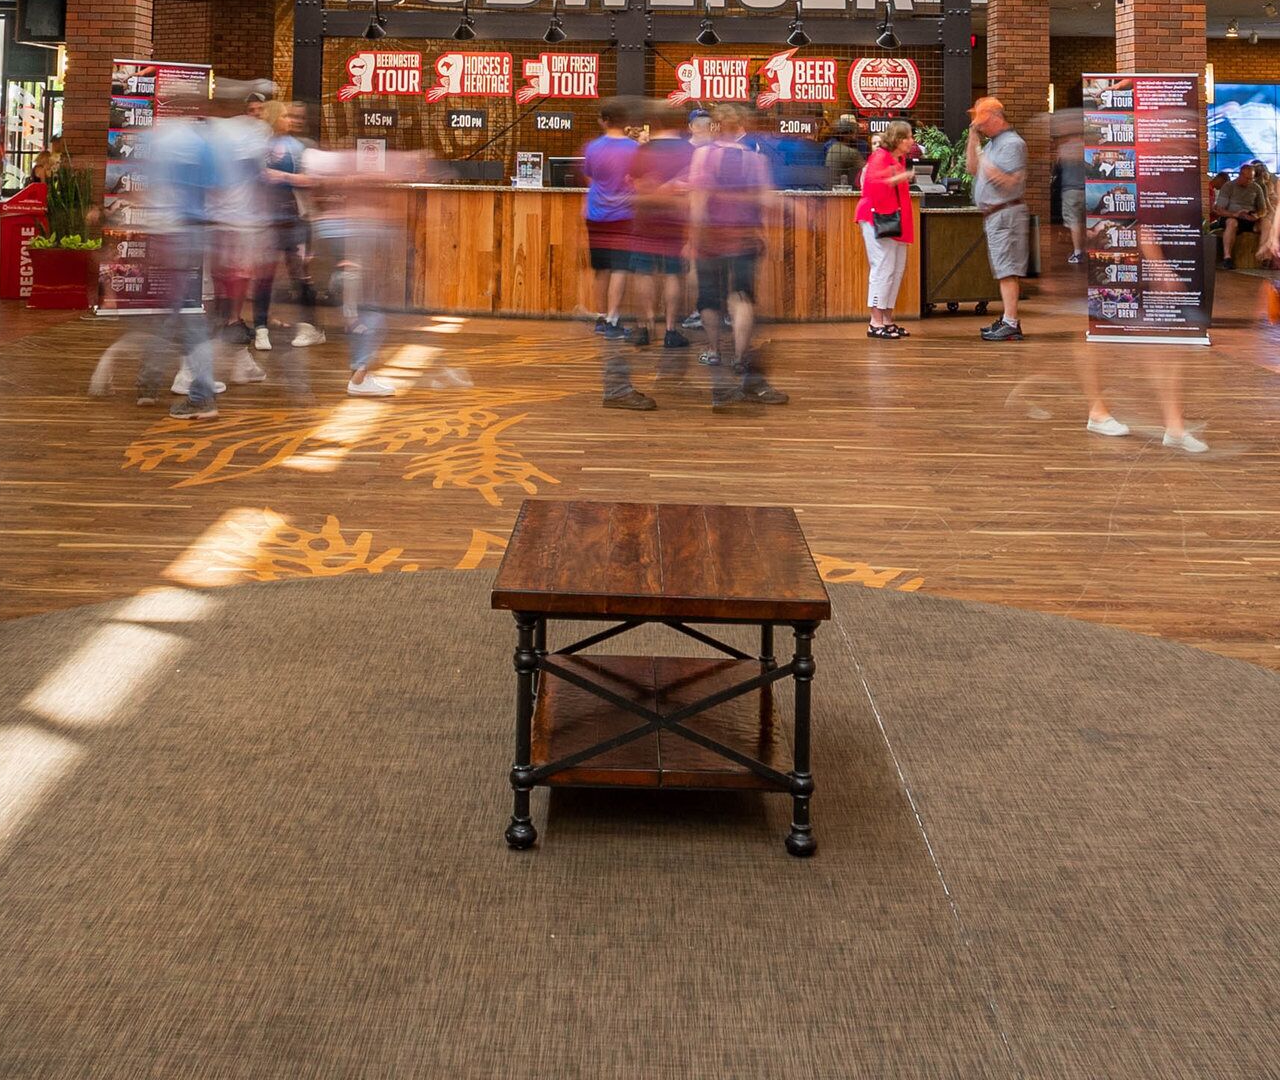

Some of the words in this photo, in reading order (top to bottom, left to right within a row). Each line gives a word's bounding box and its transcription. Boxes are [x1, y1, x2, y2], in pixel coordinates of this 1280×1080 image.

[377, 54, 419, 67] BEERMASTER
[464, 56, 500, 74] HORSES
[503, 56, 509, 74] &
[552, 55, 568, 72] DAY
[570, 56, 596, 73] FRESH
[703, 60, 747, 75] BREWERY
[795, 61, 834, 83] BEER
[376, 70, 419, 92] TOUR
[464, 75, 509, 94] HERITAGE
[552, 73, 595, 95] TOUR
[860, 77, 908, 88] BIERGARTEN
[704, 77, 746, 99] TOUR
[795, 84, 835, 100] SCHOOL
[1113, 97, 1133, 108] TOUR
[135, 115, 153, 126] TOUR
[364, 113, 381, 125] 1:45
[382, 117, 392, 125] PM
[451, 115, 471, 128] 2:00
[472, 118, 482, 128] PM
[537, 116, 560, 129] 12:40
[561, 120, 570, 129] PM
[780, 121, 800, 133] 2:00
[801, 124, 811, 133] PM
[1113, 132, 1134, 142] TOUR
[1114, 201, 1136, 212] TOUR
